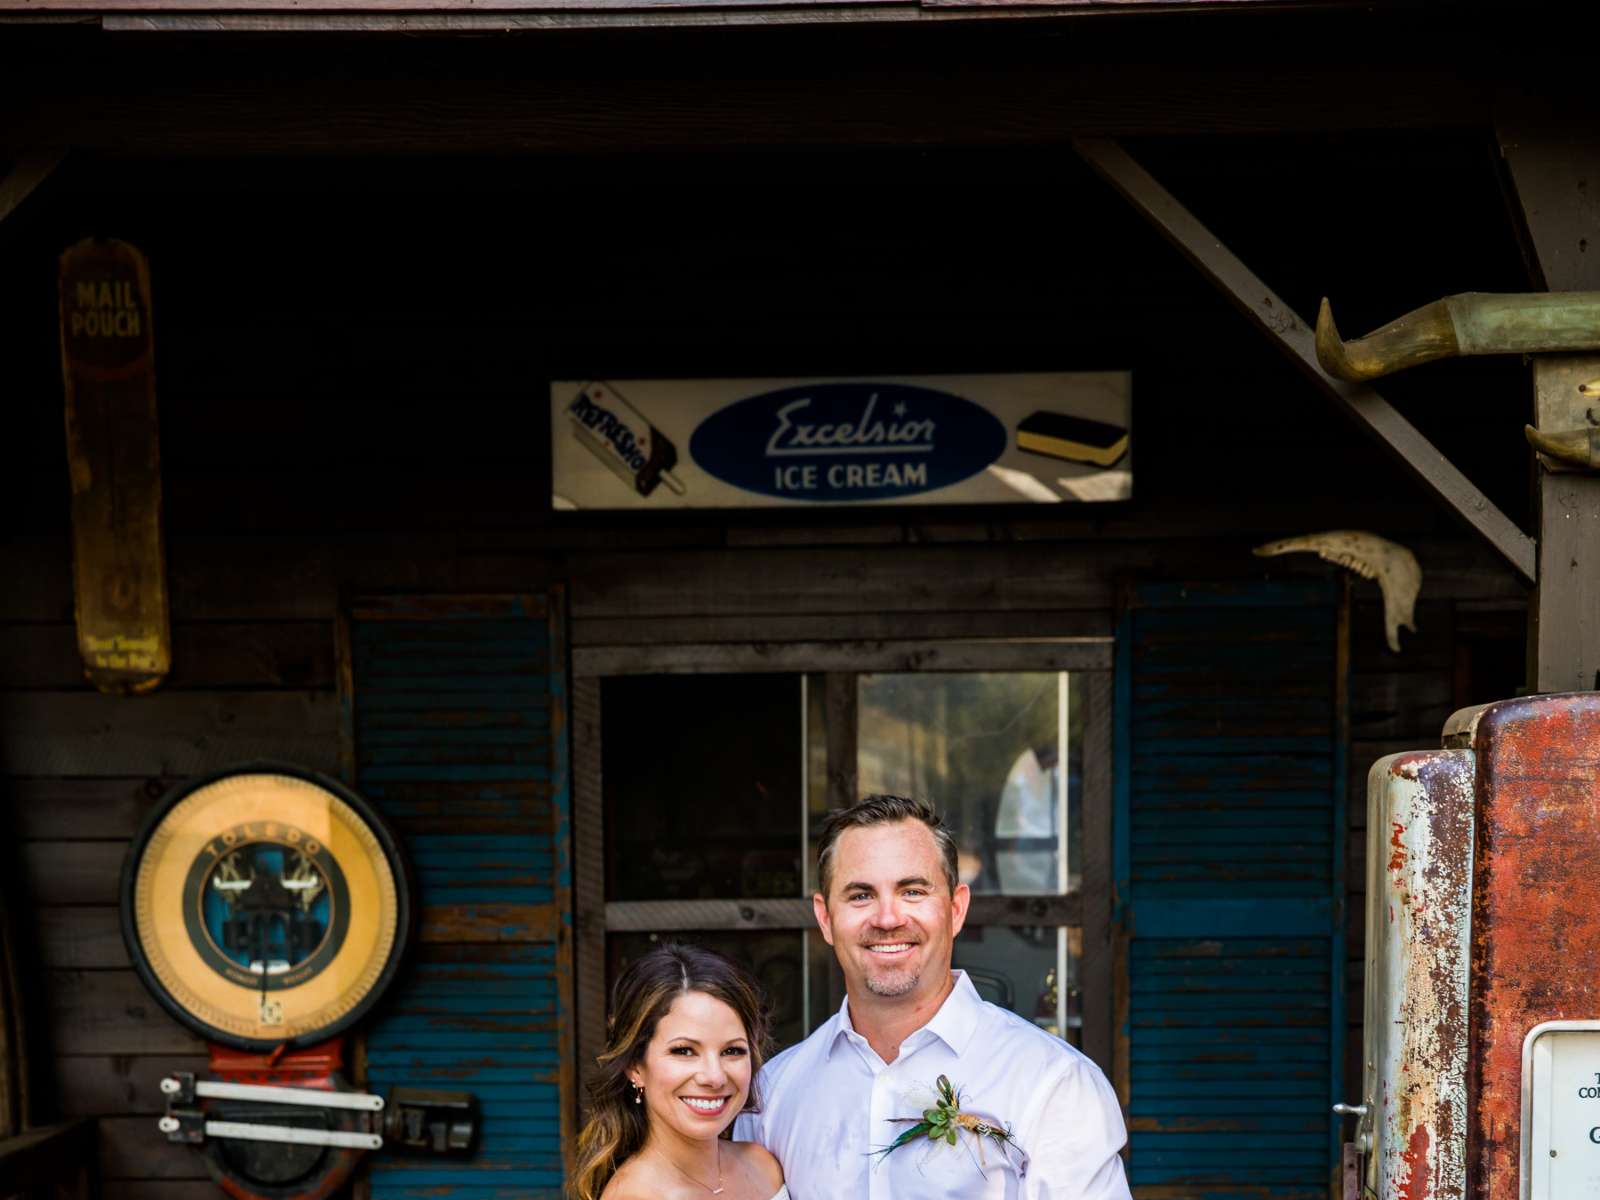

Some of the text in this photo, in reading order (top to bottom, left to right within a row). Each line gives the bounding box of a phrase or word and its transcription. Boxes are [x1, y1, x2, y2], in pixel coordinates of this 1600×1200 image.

[76, 280, 137, 308] MAIL
[71, 311, 140, 337] POUCH
[765, 393, 936, 456] Excelsior
[775, 463, 928, 490] ICE CREAM
[206, 822, 321, 858] TOLEDO
